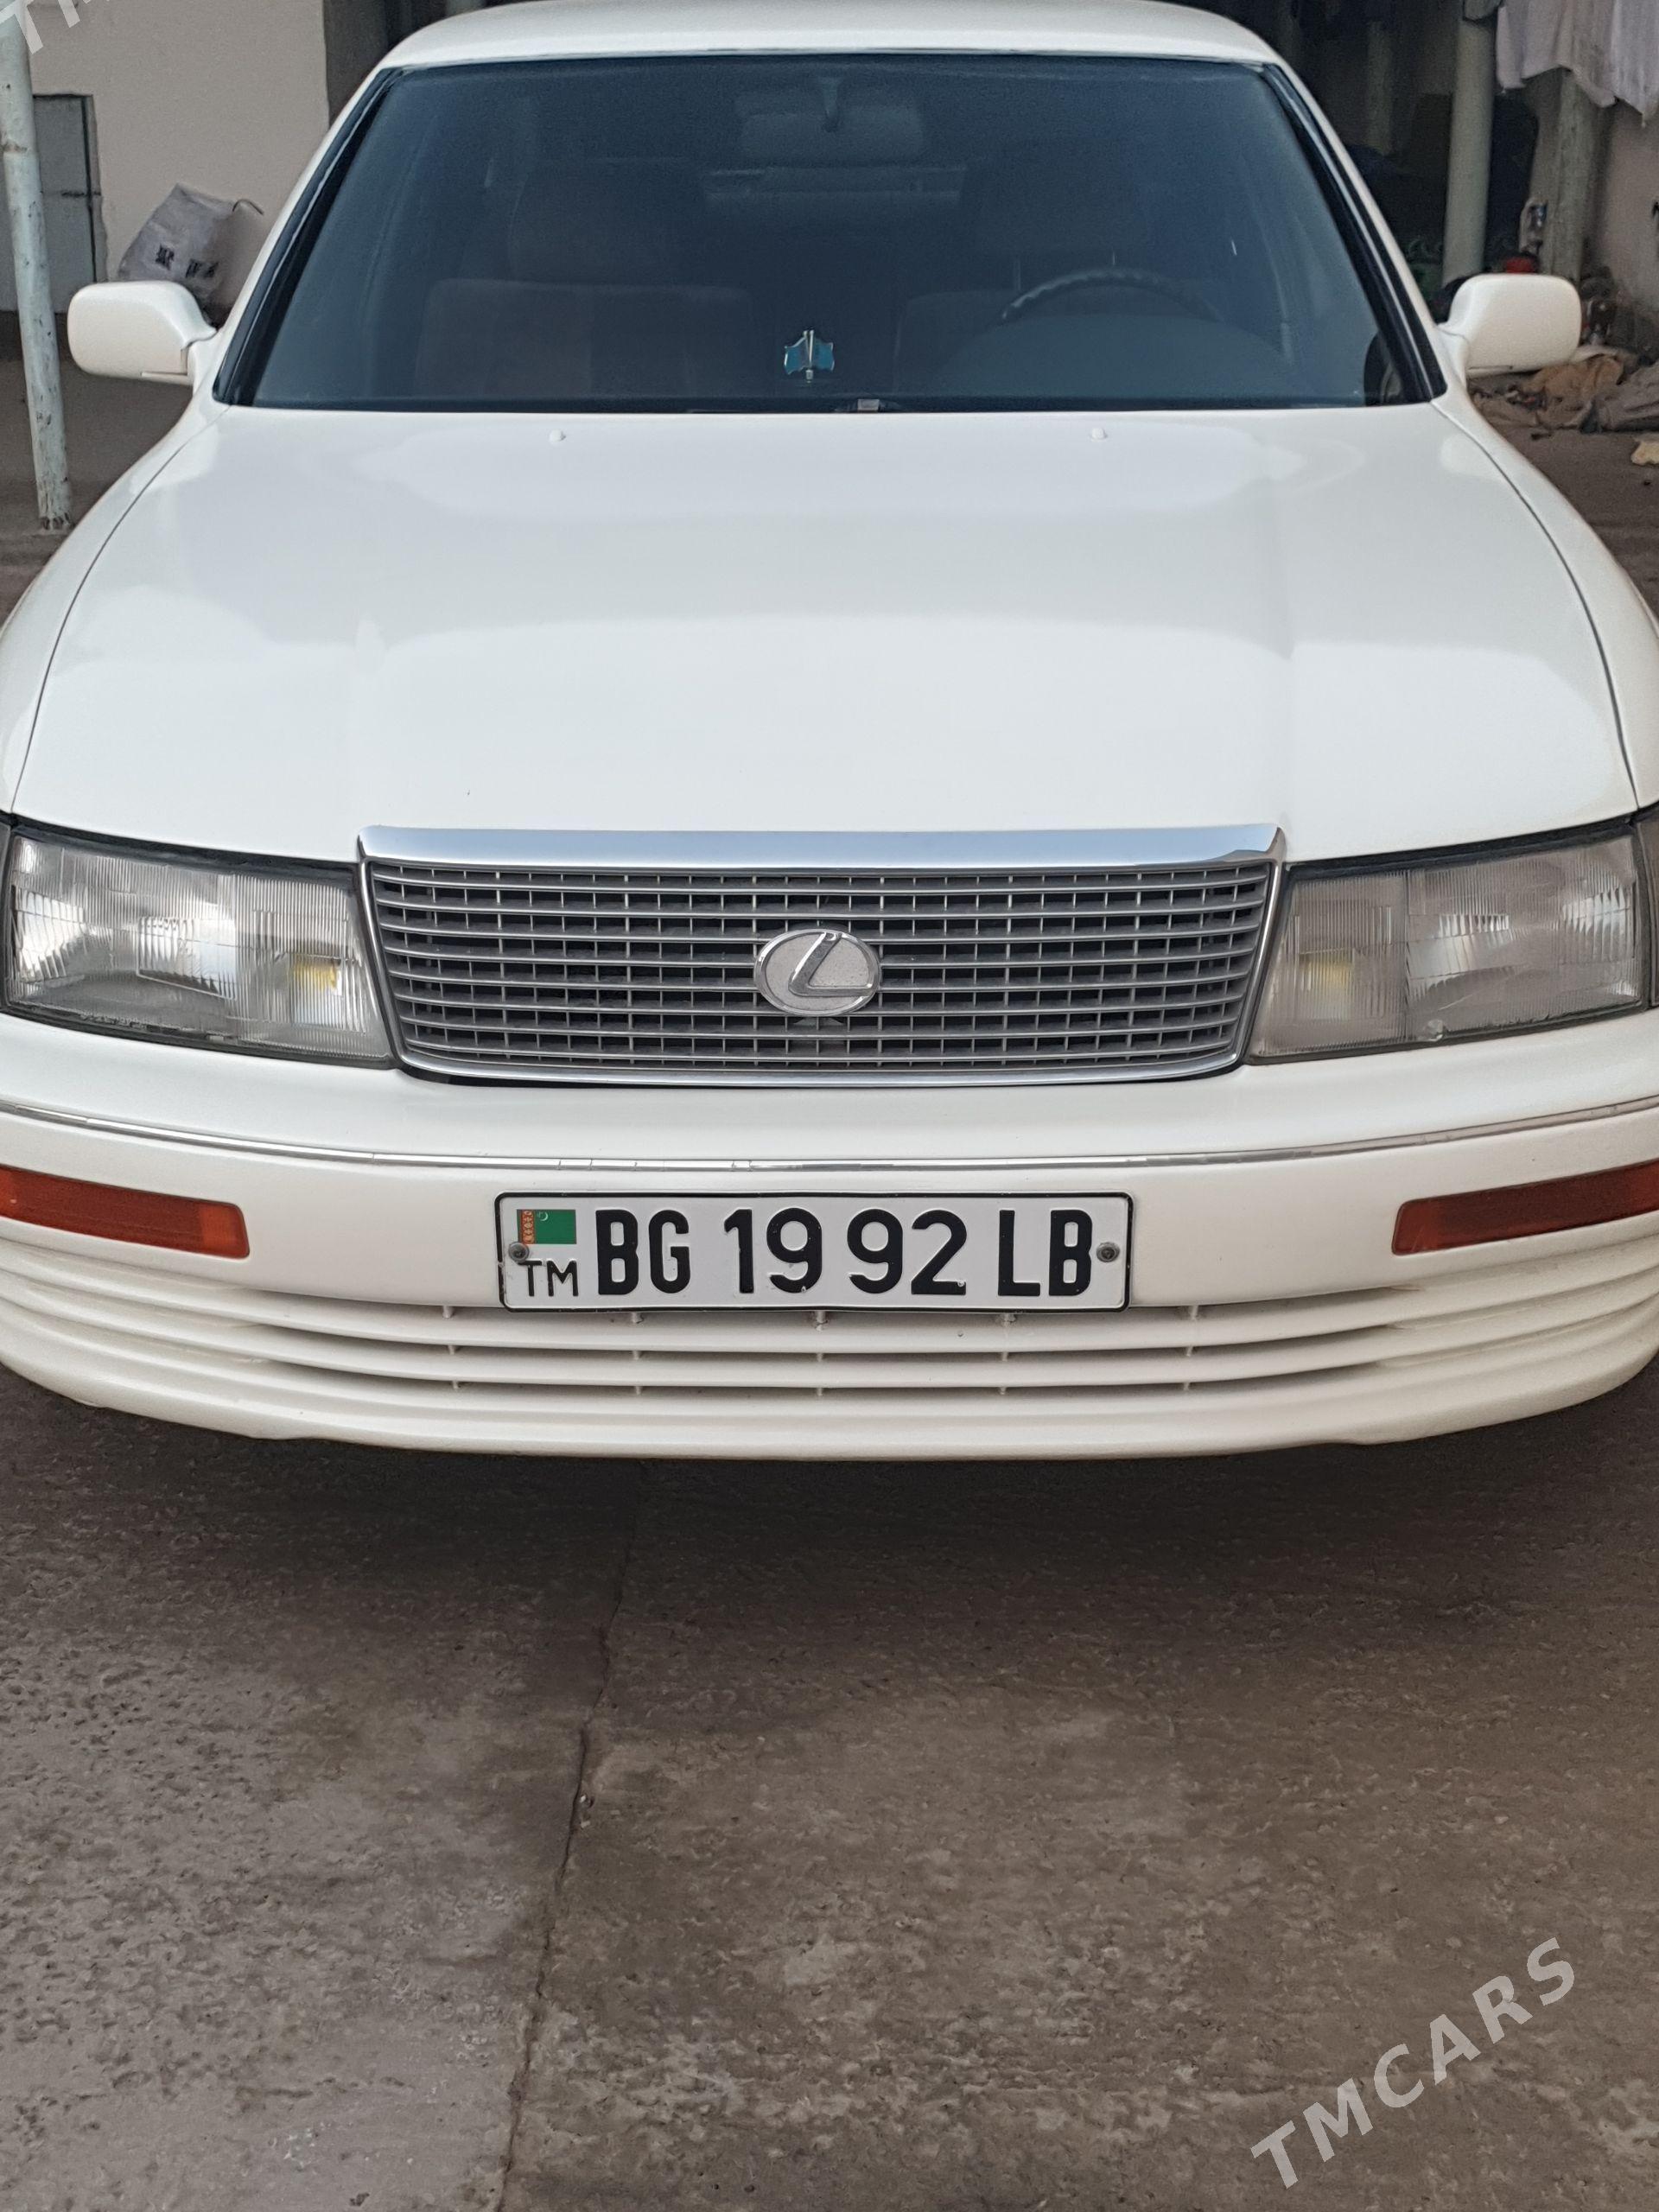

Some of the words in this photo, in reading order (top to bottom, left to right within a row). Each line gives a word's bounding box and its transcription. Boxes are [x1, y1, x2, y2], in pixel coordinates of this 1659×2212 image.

[518, 1259, 579, 1296] TM
[595, 1209, 690, 1295] BG
[997, 1209, 1093, 1296] LB
